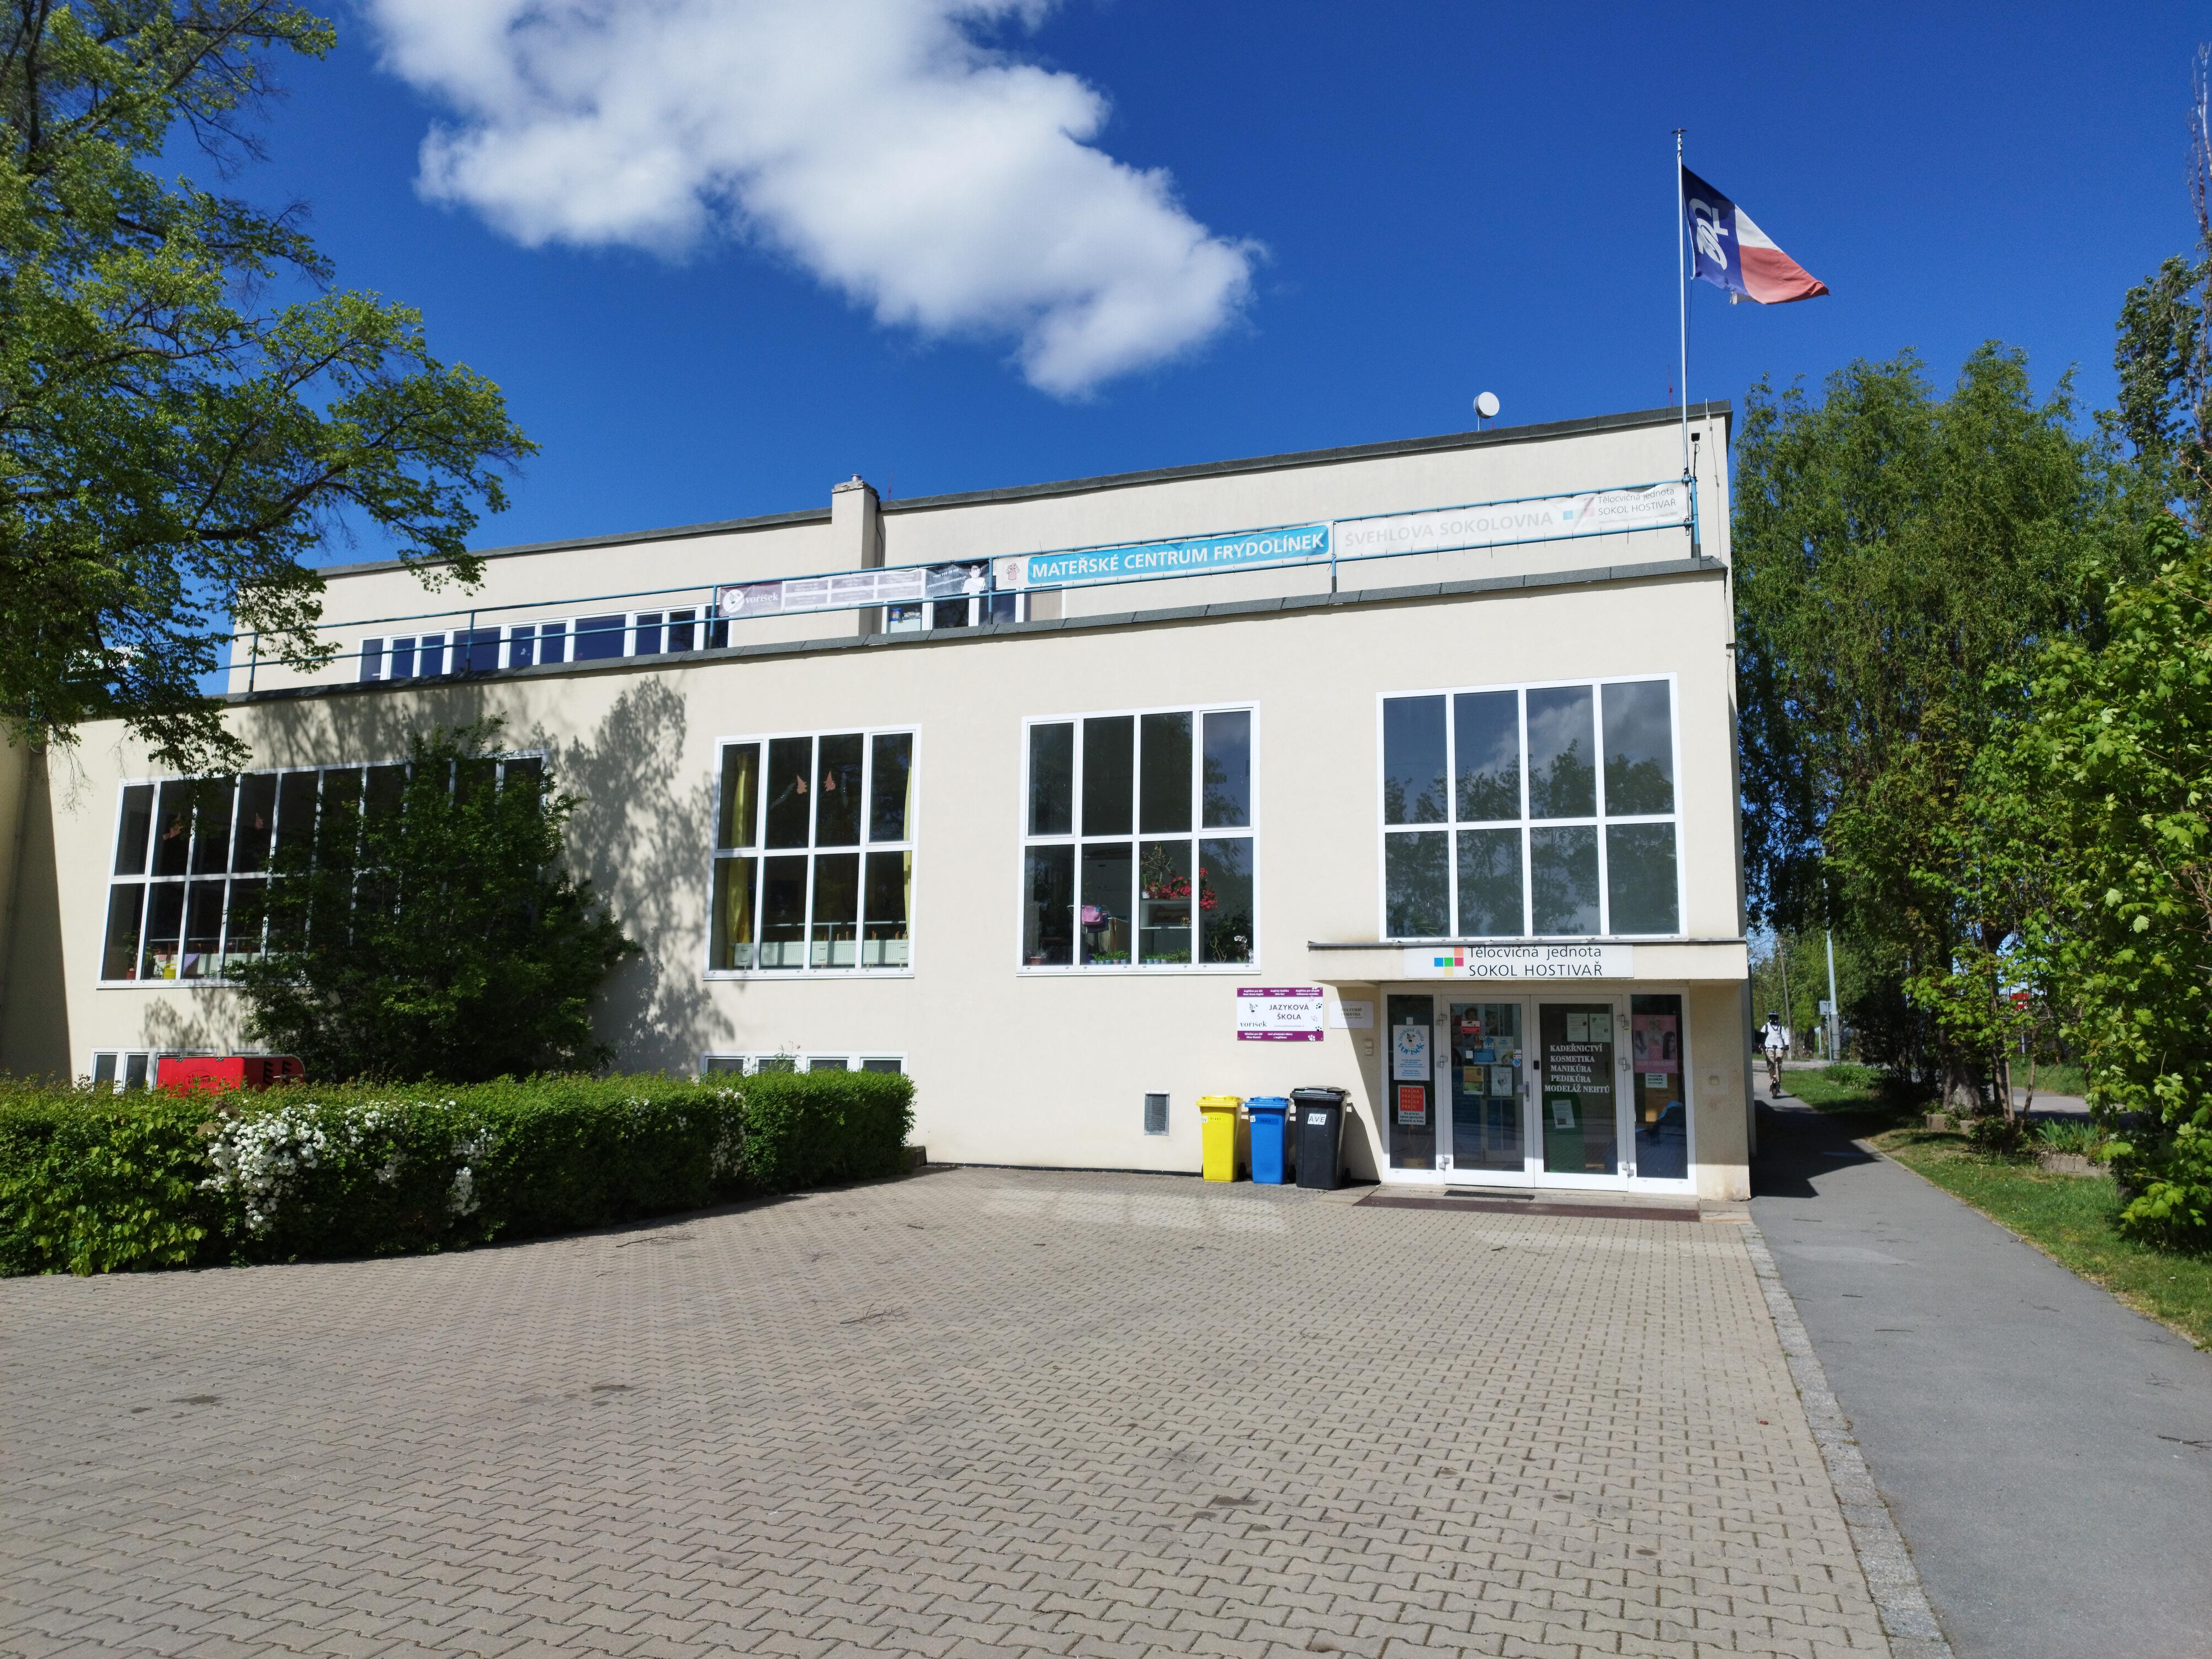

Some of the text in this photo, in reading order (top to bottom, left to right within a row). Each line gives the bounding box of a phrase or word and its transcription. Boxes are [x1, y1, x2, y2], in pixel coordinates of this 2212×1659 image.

[1598, 488, 1674, 504] Tělocvičná jednota
[1598, 498, 1677, 516] SOKOL HOSTIVAŘ
[1345, 511, 1553, 546] ŠVEHLOVA SOKOLOVNA
[1032, 532, 1325, 578] MATEŘSKÉ CENTRUM FRYDOLÍNEK
[1467, 946, 1601, 960] Tělocvičná jednota
[1469, 961, 1603, 977] SOKOL HOSTIVAŘ
[1550, 1043, 1603, 1052] KADEŘNICTVÍ
[1550, 1064, 1592, 1072] MANIKÚRA
[1551, 1074, 1592, 1083] PEDIKÚRA
[1545, 1084, 1610, 1093] MODELÁŽ NEHTŮ
